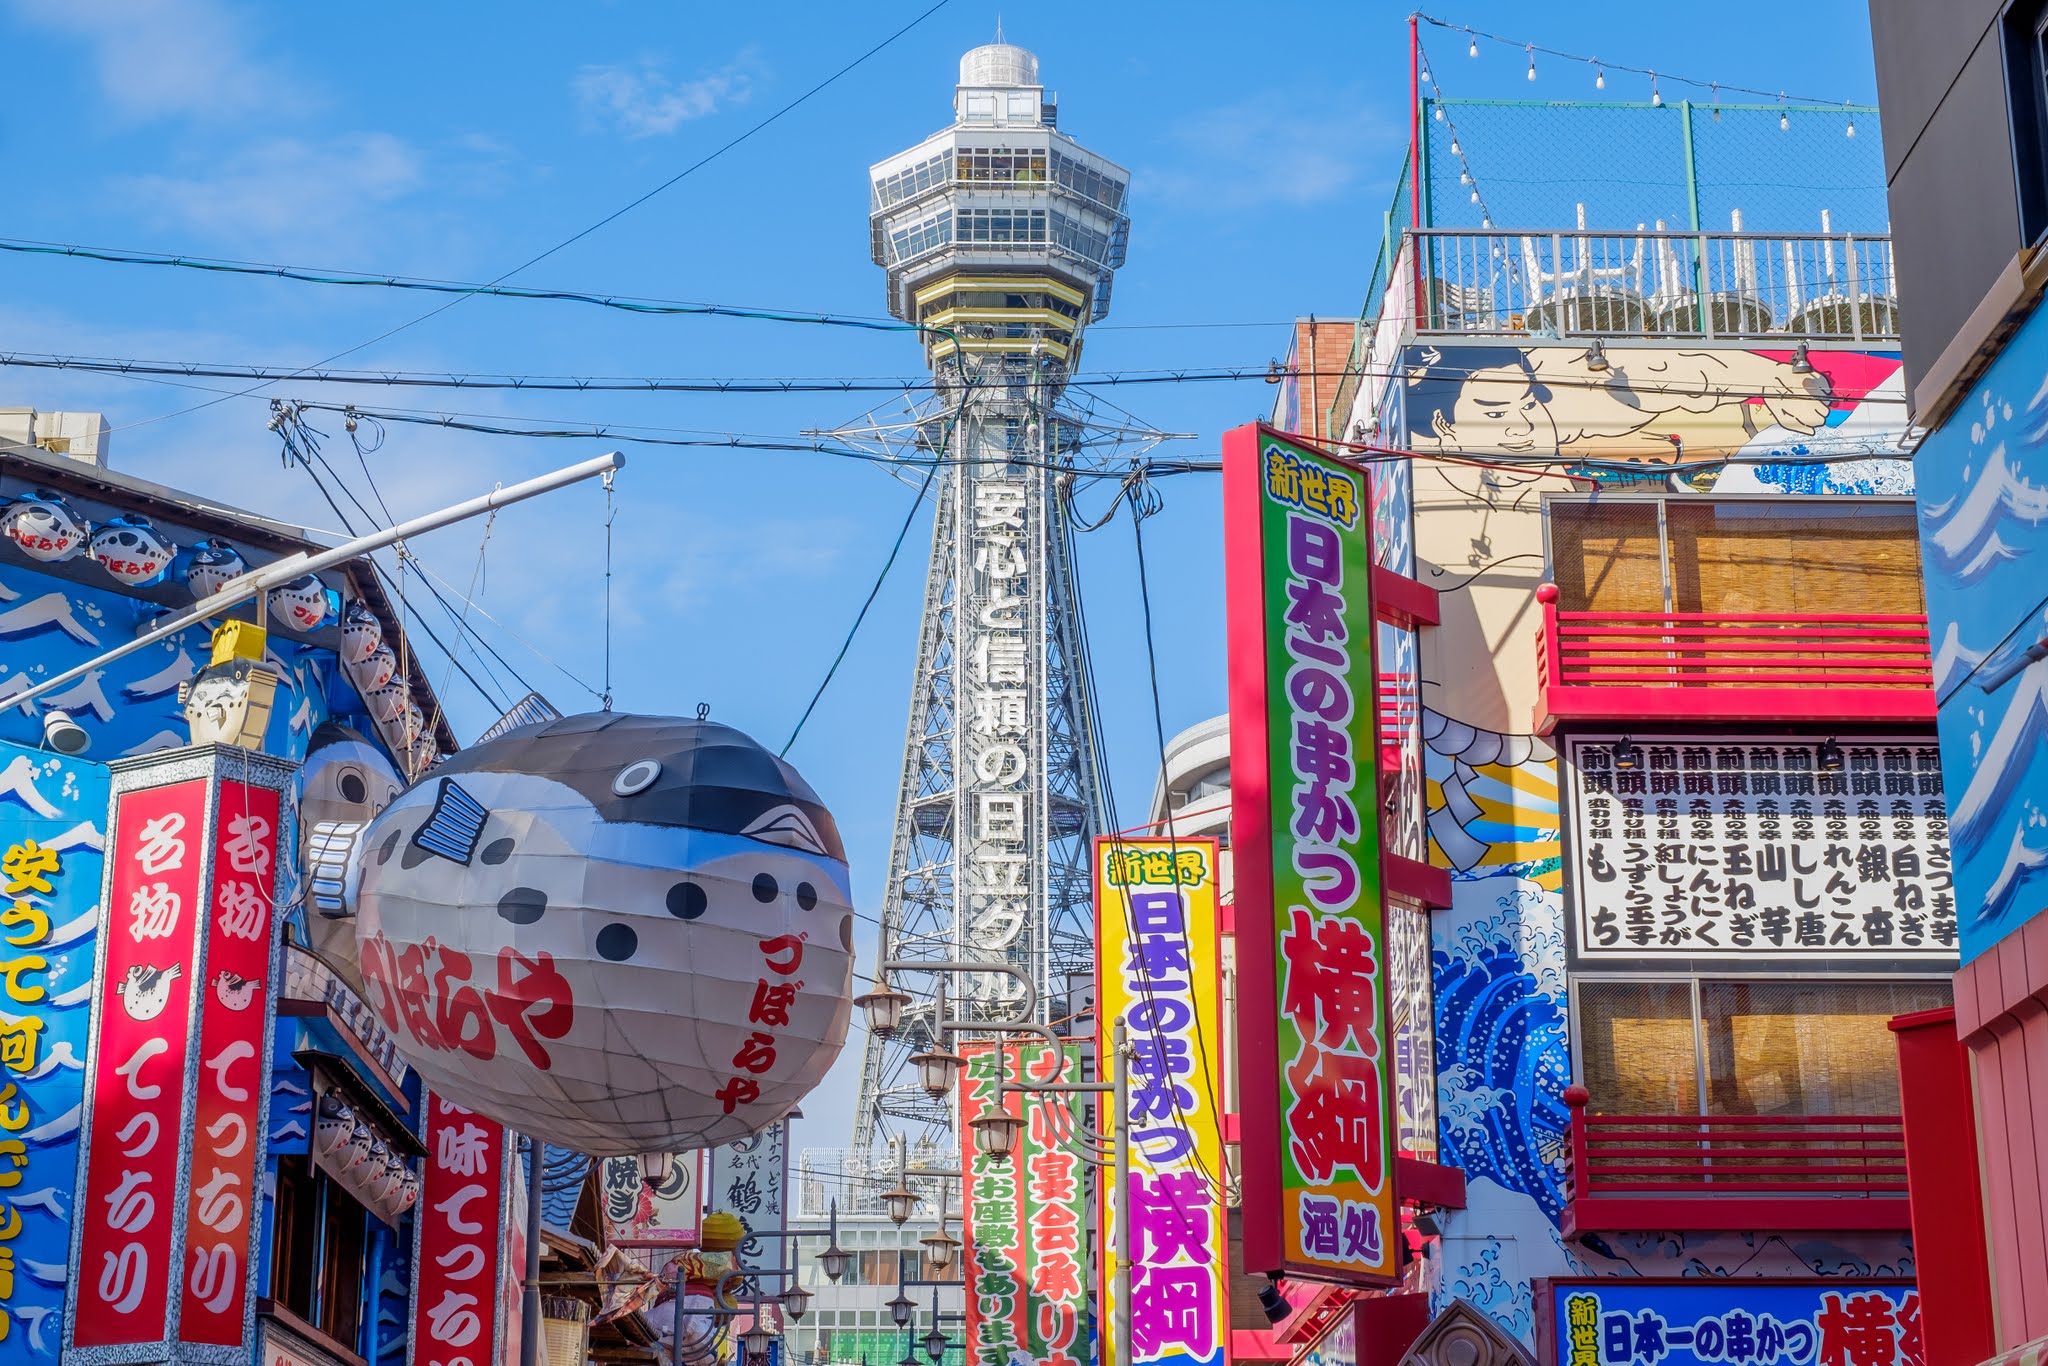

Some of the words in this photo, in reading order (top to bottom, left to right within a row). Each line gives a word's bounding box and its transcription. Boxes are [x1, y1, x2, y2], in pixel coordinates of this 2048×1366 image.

[1268, 450, 1357, 526] 新世界
[98, 554, 156, 575] づぼらや
[969, 482, 1028, 1039] 安心と信頼の日立グル
[1287, 516, 1356, 904] 日本一の串かつ
[1581, 746, 1613, 794] 前頭
[1648, 746, 1680, 795] 前頭
[1682, 746, 1714, 795] 前頭
[1715, 747, 1748, 795] 前頭
[1749, 747, 1781, 795] 前頭
[1782, 747, 1815, 795] 前頭
[1849, 748, 1882, 796] 前頭
[1882, 748, 1915, 796] 前頭
[1915, 748, 1944, 796] 前頭
[129, 812, 186, 943] 名物
[218, 813, 271, 941] 名物
[1108, 850, 1206, 885] 新世界
[1587, 843, 1620, 946] もち
[1621, 843, 1657, 946] うずら玉子
[1653, 843, 1691, 946] 紅しょうが
[1687, 843, 1723, 946] にんにく
[1722, 843, 1759, 946] 玉ねぎ
[1756, 843, 1792, 946] 山芋
[1791, 843, 1827, 946] しし唐
[1823, 843, 1861, 946] れんこん
[1855, 843, 1894, 946] 銀杏
[1892, 843, 1928, 946] 白ねぎ
[1925, 843, 1958, 946] さつま芋
[360, 930, 573, 1070] づぼらや
[715, 932, 809, 1115] づぼらや
[1127, 892, 1193, 1163] 日本一の串かつ
[1285, 910, 1381, 1191] 横綱
[728, 1155, 762, 1169] 名代
[766, 1122, 783, 1165] 串かつ
[1112, 1171, 1213, 1357] 横綱
[1303, 1198, 1380, 1261] 酒処
[1570, 1298, 1598, 1366] 新世界
[1604, 1312, 1813, 1363] 日本一の串かつ
